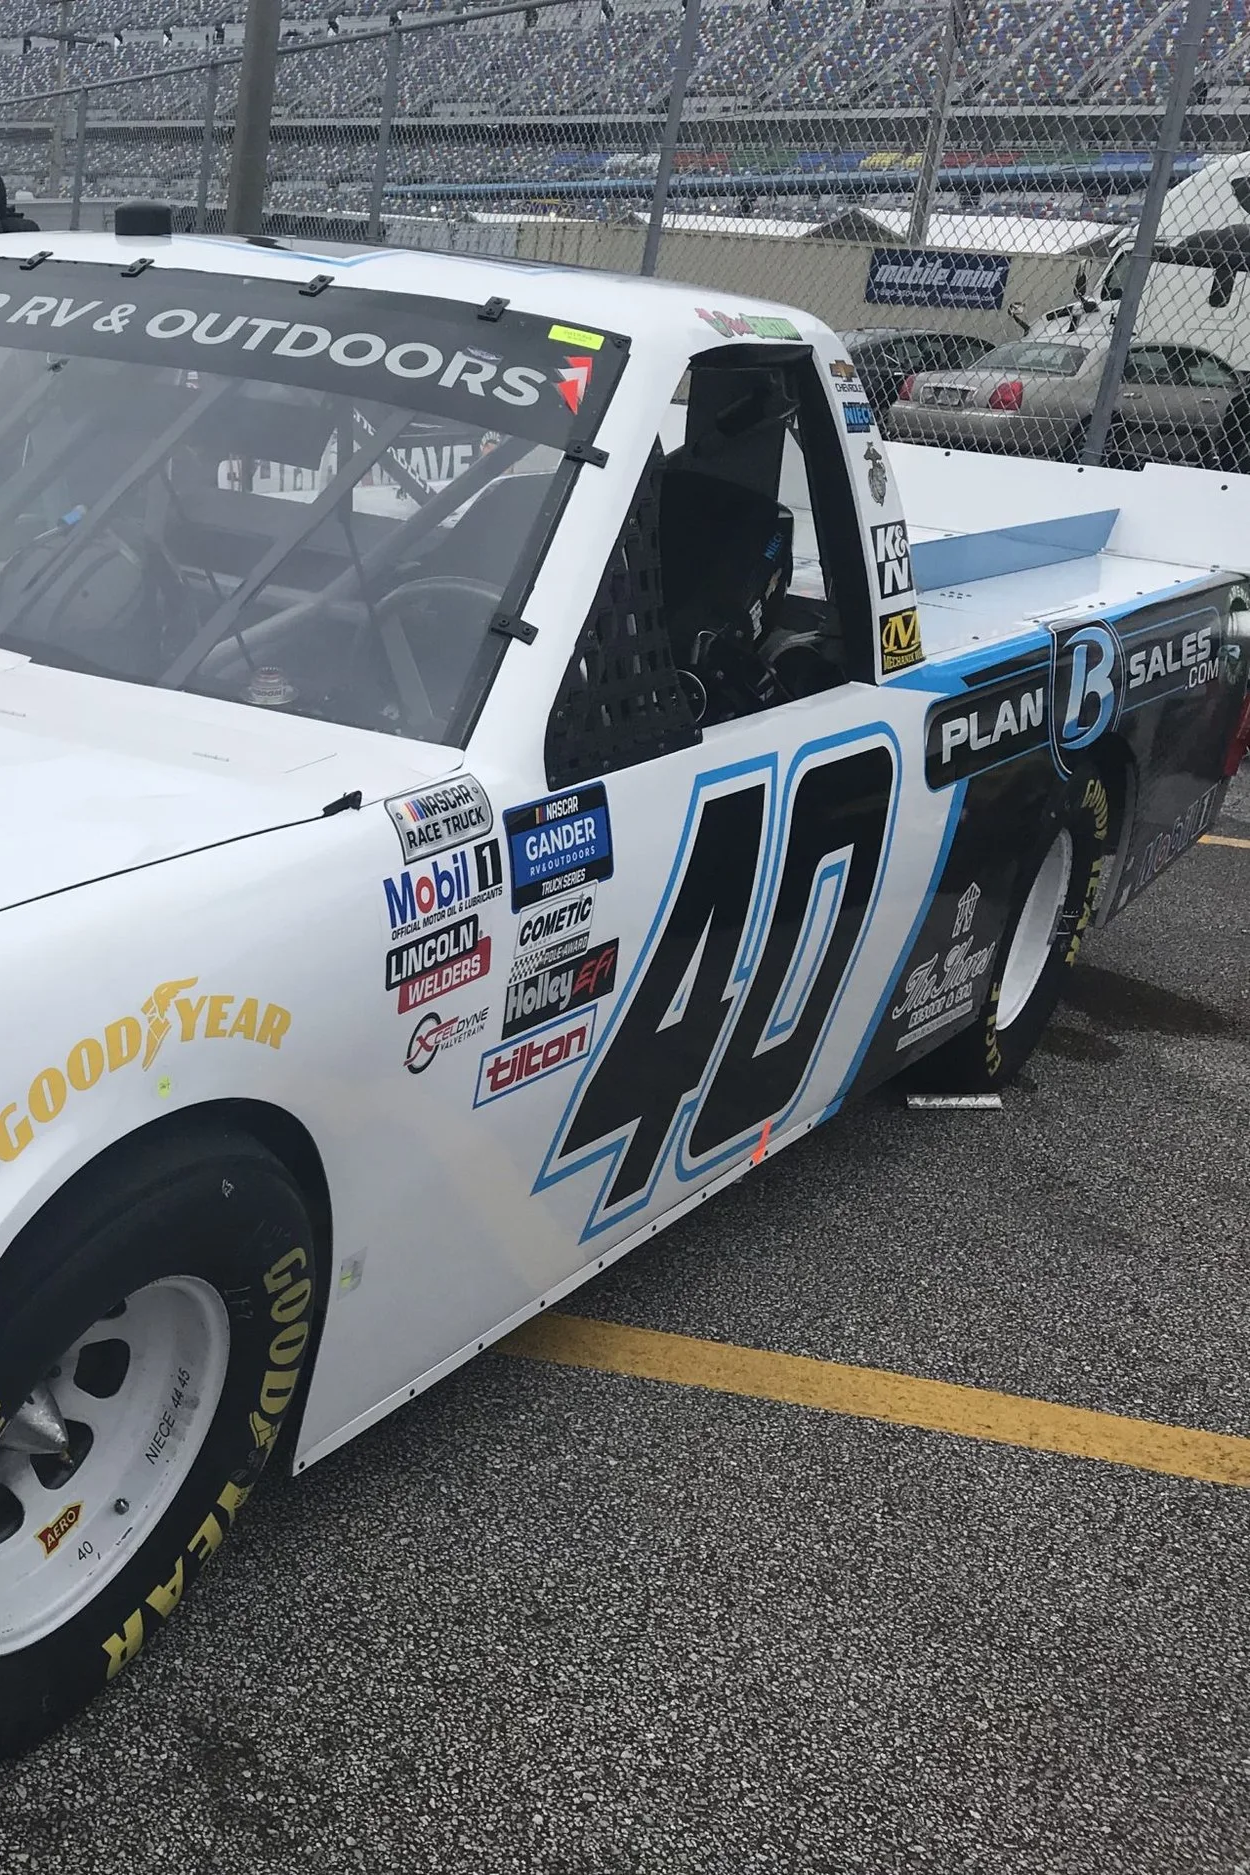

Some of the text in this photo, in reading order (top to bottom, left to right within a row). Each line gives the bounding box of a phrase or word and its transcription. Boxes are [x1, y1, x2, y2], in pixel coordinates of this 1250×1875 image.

[874, 257, 950, 286] mobile
[6, 296, 104, 328] RV
[92, 303, 138, 335] &
[145, 308, 548, 407] OUTDOORS
[941, 687, 1044, 764] PLAN
[1128, 627, 1212, 690] SALES
[418, 783, 475, 819] NASCAR
[545, 795, 579, 822] NASCAR
[406, 806, 486, 850] RACE TRUCK
[525, 816, 597, 862] GANDER
[383, 845, 495, 929] Mobil 1
[541, 868, 586, 896] TRUCK SERIES
[391, 921, 421, 941] OFFICIAL
[422, 911, 447, 928] MOTOR
[447, 906, 457, 918] OIL
[464, 886, 503, 911] LUBRICANTS
[519, 896, 593, 947] COMETIC
[391, 919, 475, 985] LINCOLN
[407, 953, 481, 1006] WELDERS
[505, 968, 575, 1024] Holley
[545, 735, 899, 1222] 40
[440, 1023, 486, 1051] VALVETRAIN
[486, 1024, 587, 1093] tilton
[145, 1411, 176, 1465] NIECE
[46, 1509, 77, 1547] AERO
[77, 1541, 94, 1561] 40
